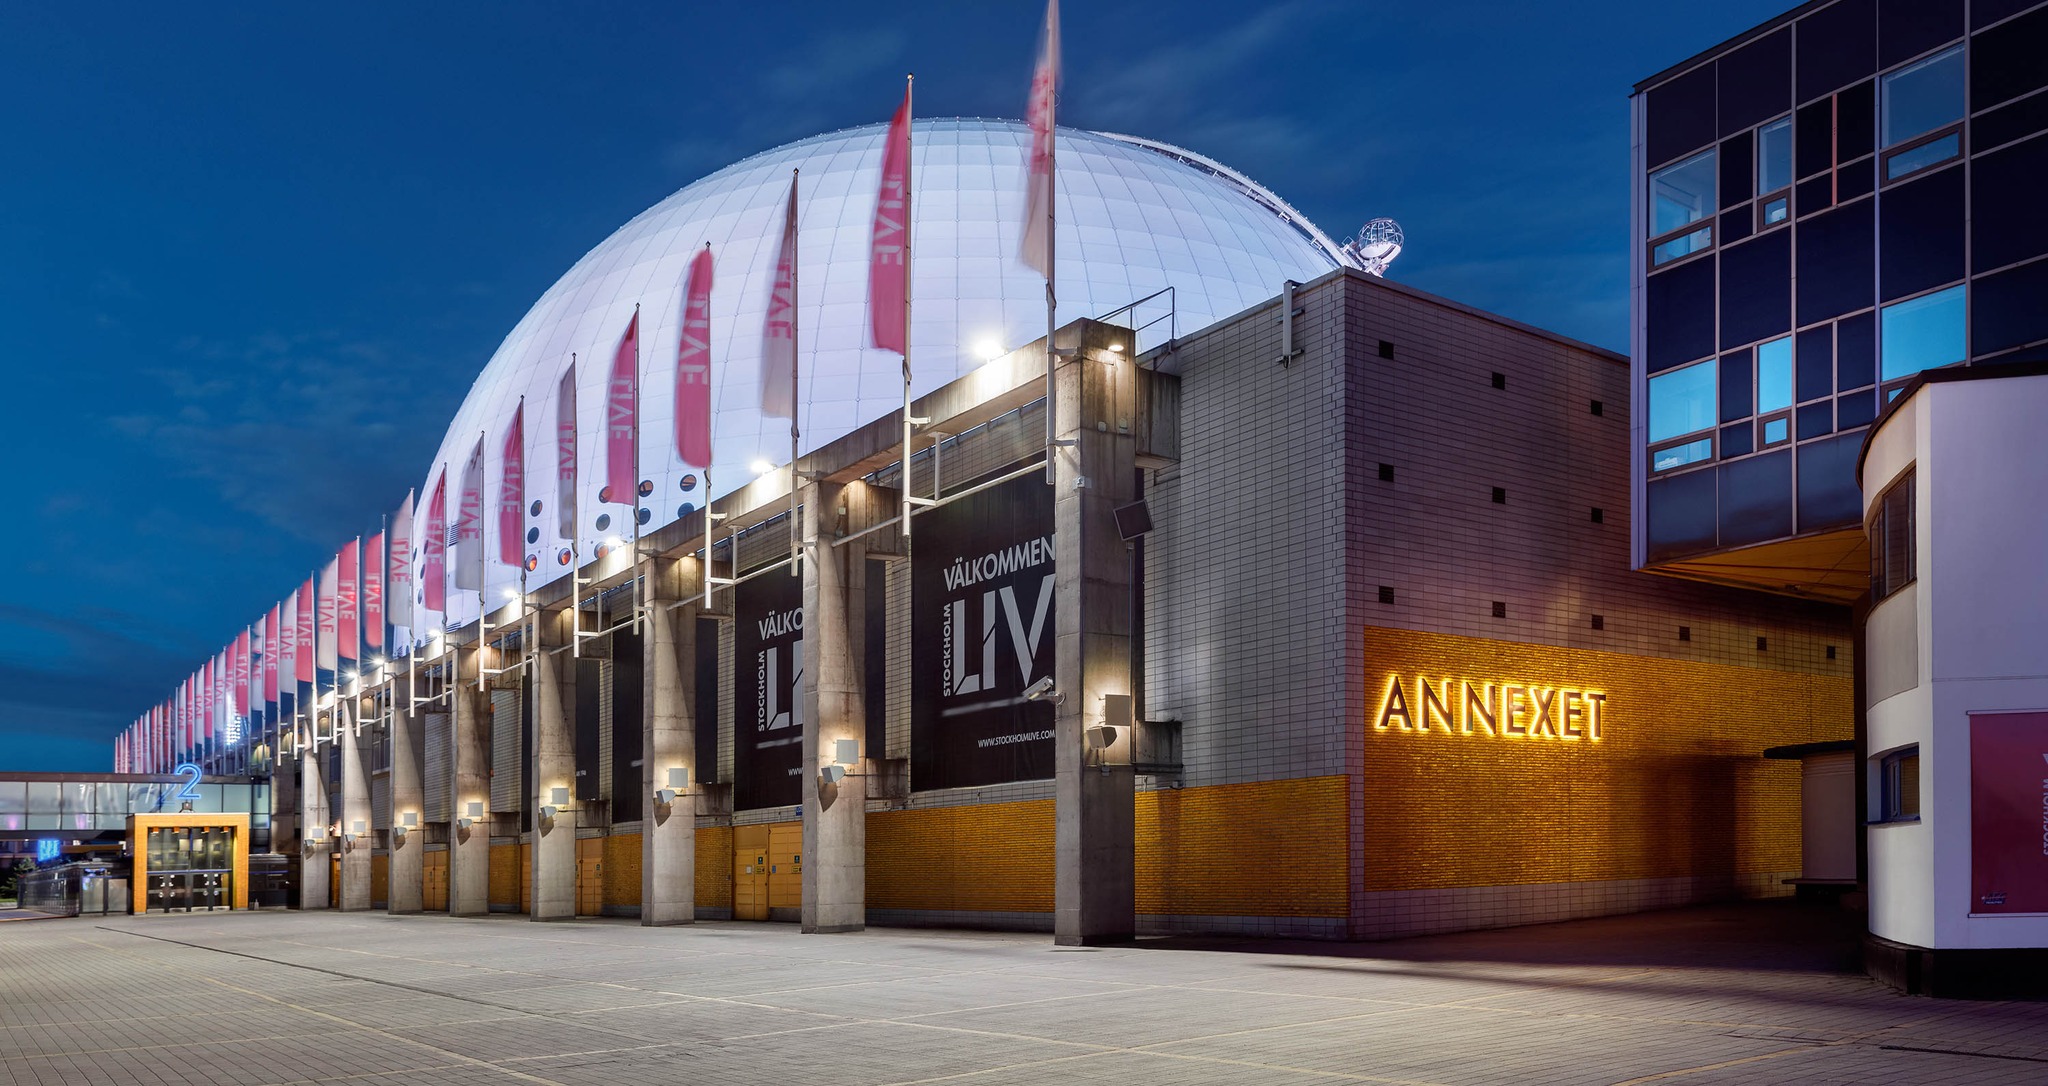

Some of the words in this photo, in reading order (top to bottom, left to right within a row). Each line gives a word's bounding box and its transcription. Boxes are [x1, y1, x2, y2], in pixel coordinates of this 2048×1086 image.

[943, 533, 1056, 592] VÄLKOMMEN
[758, 607, 803, 640] VÄLKO
[943, 603, 951, 697] STOCKHOLM
[1376, 675, 1606, 739] ANNEXET
[978, 729, 1056, 748] WWW.STOCKHOLMLIVE.COM
[174, 763, 202, 799] 2
